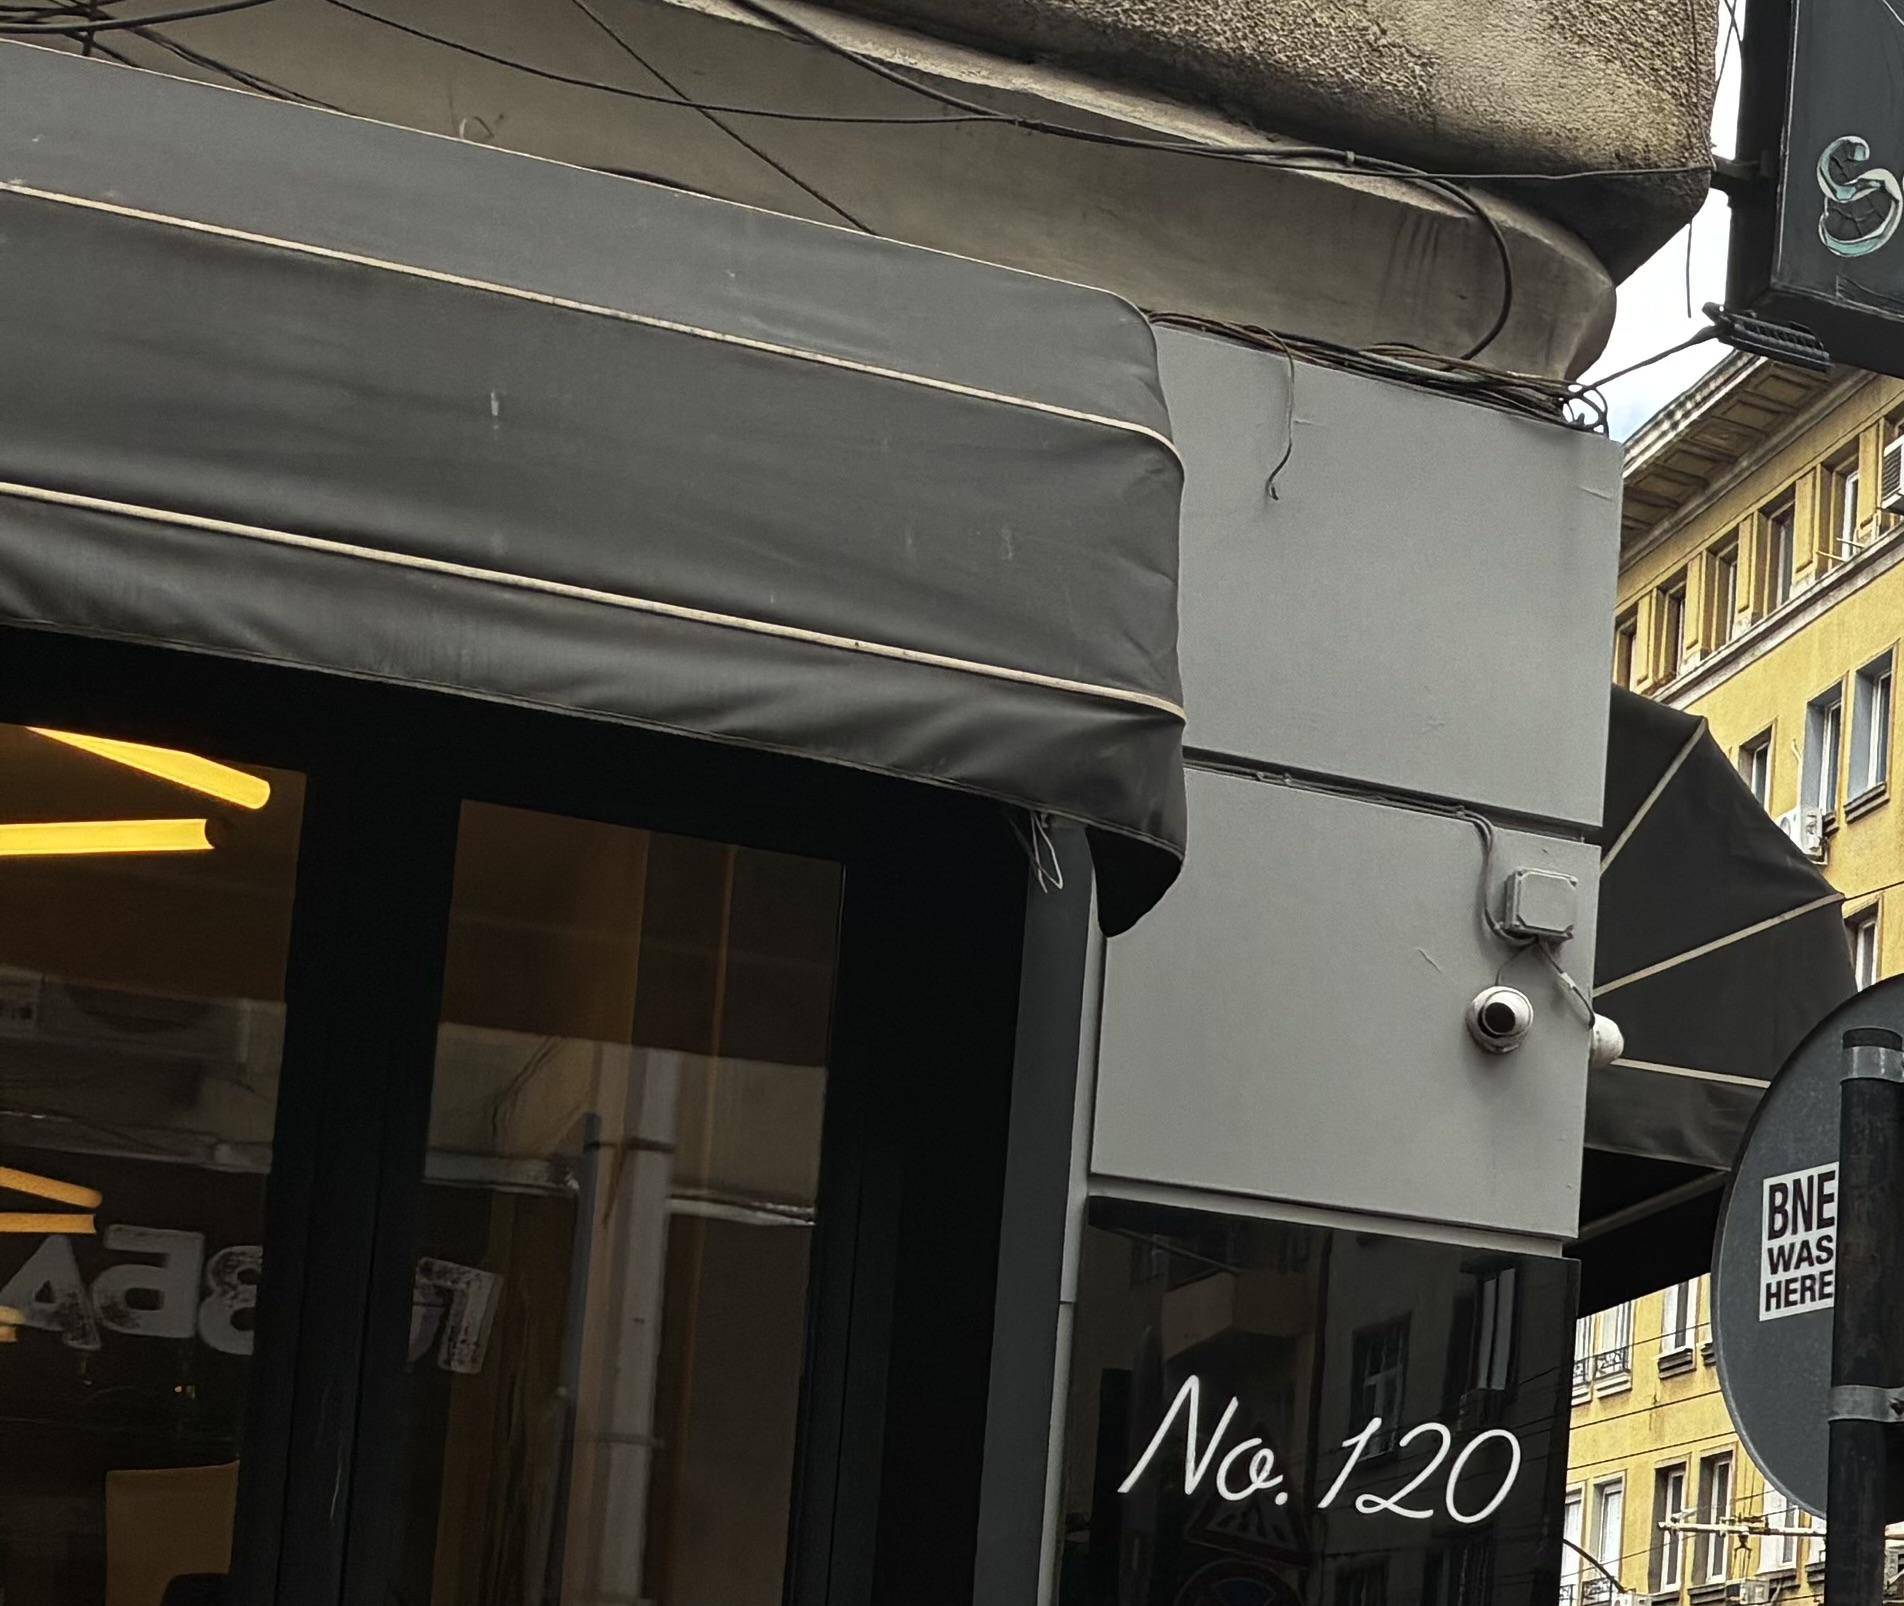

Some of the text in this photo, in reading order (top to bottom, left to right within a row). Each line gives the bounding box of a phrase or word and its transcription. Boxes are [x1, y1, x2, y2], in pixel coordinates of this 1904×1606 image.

[1767, 1170, 1836, 1241] BNE
[1767, 1235, 1834, 1275] WAS
[1765, 1270, 1834, 1312] HERE
[1117, 1374, 1521, 1524] No. 120
